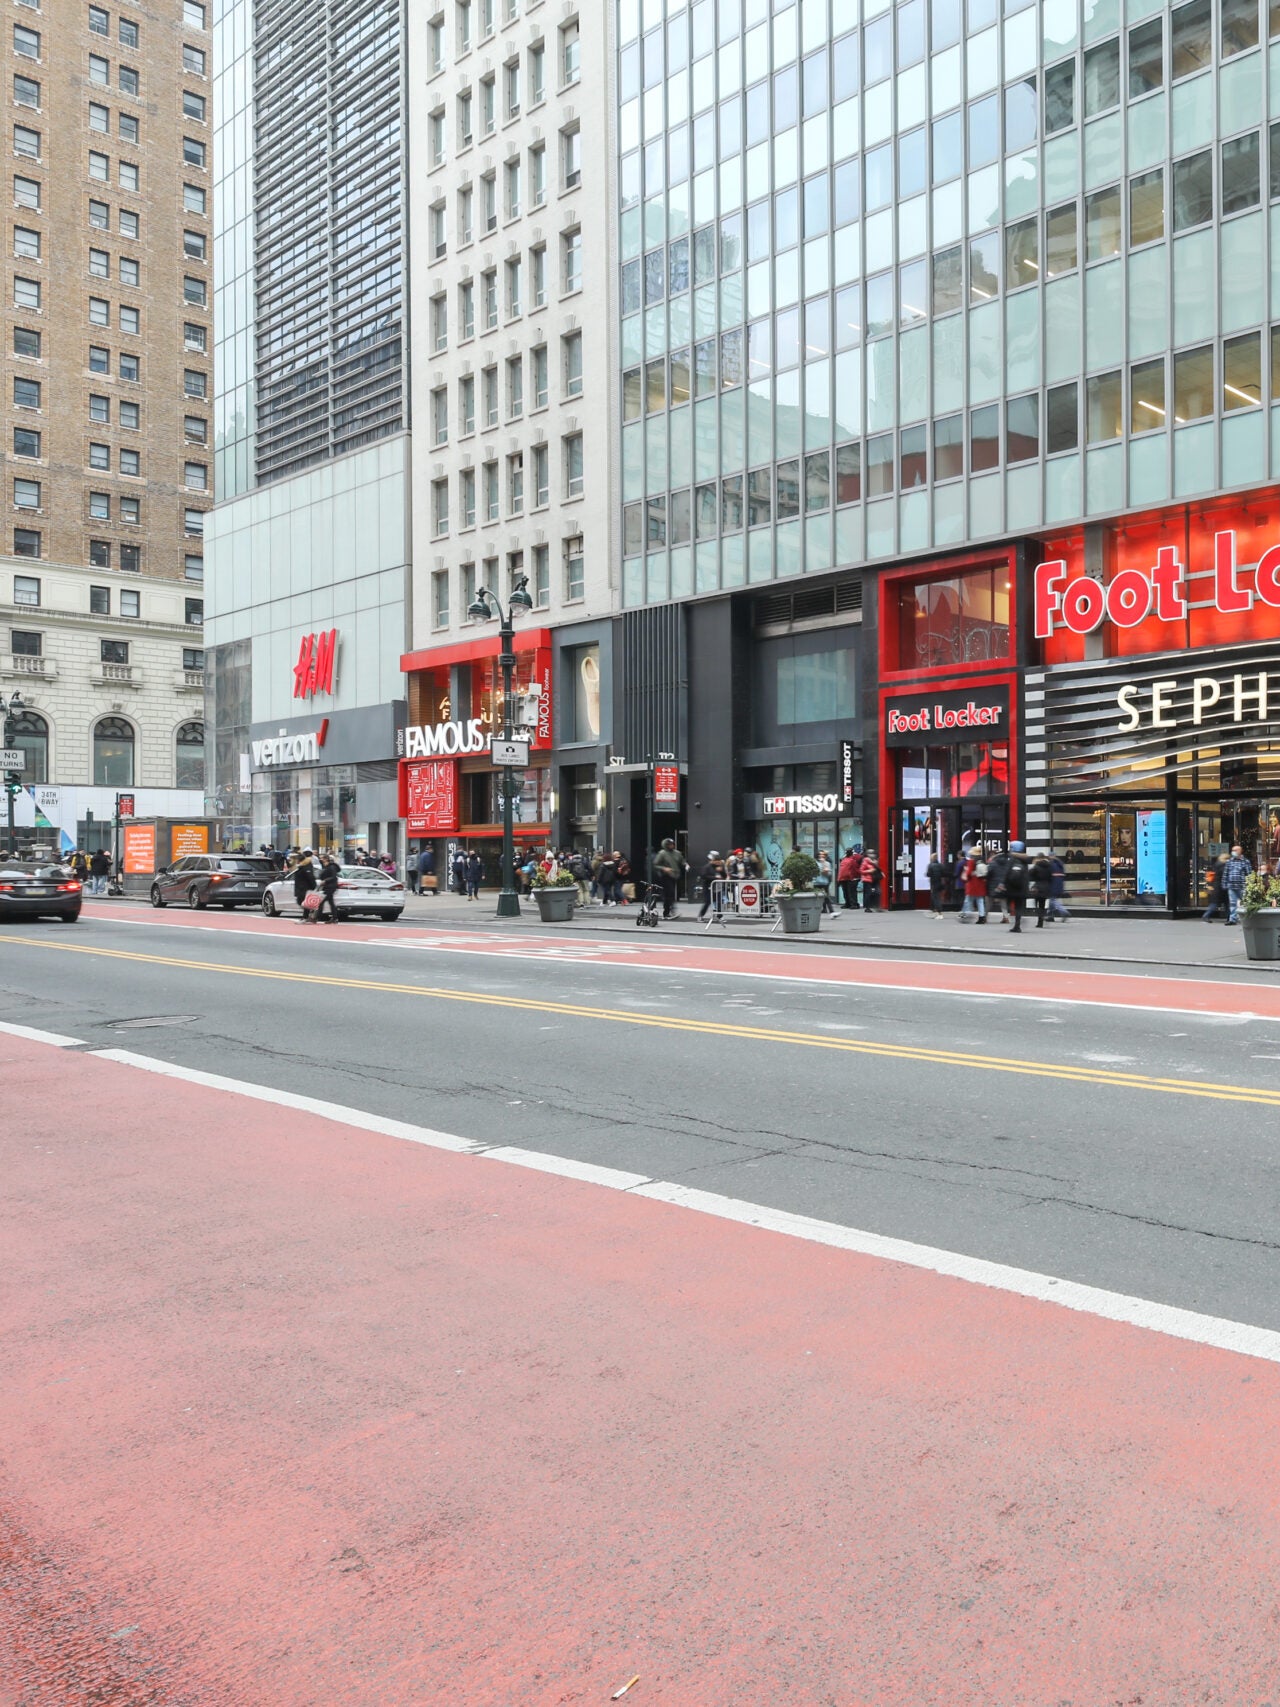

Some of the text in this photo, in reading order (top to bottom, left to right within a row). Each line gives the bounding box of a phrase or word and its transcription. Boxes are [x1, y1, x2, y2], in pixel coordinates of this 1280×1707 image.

[1034, 545, 1187, 638] Foot
[293, 628, 337, 699] H&M
[539, 692, 550, 738] FAMOUS
[888, 702, 1002, 733] Foot Locker
[251, 728, 321, 767] verizon
[395, 729, 404, 755] verizon
[405, 718, 484, 758] FAMOUS
[843, 742, 852, 785] TISSOT
